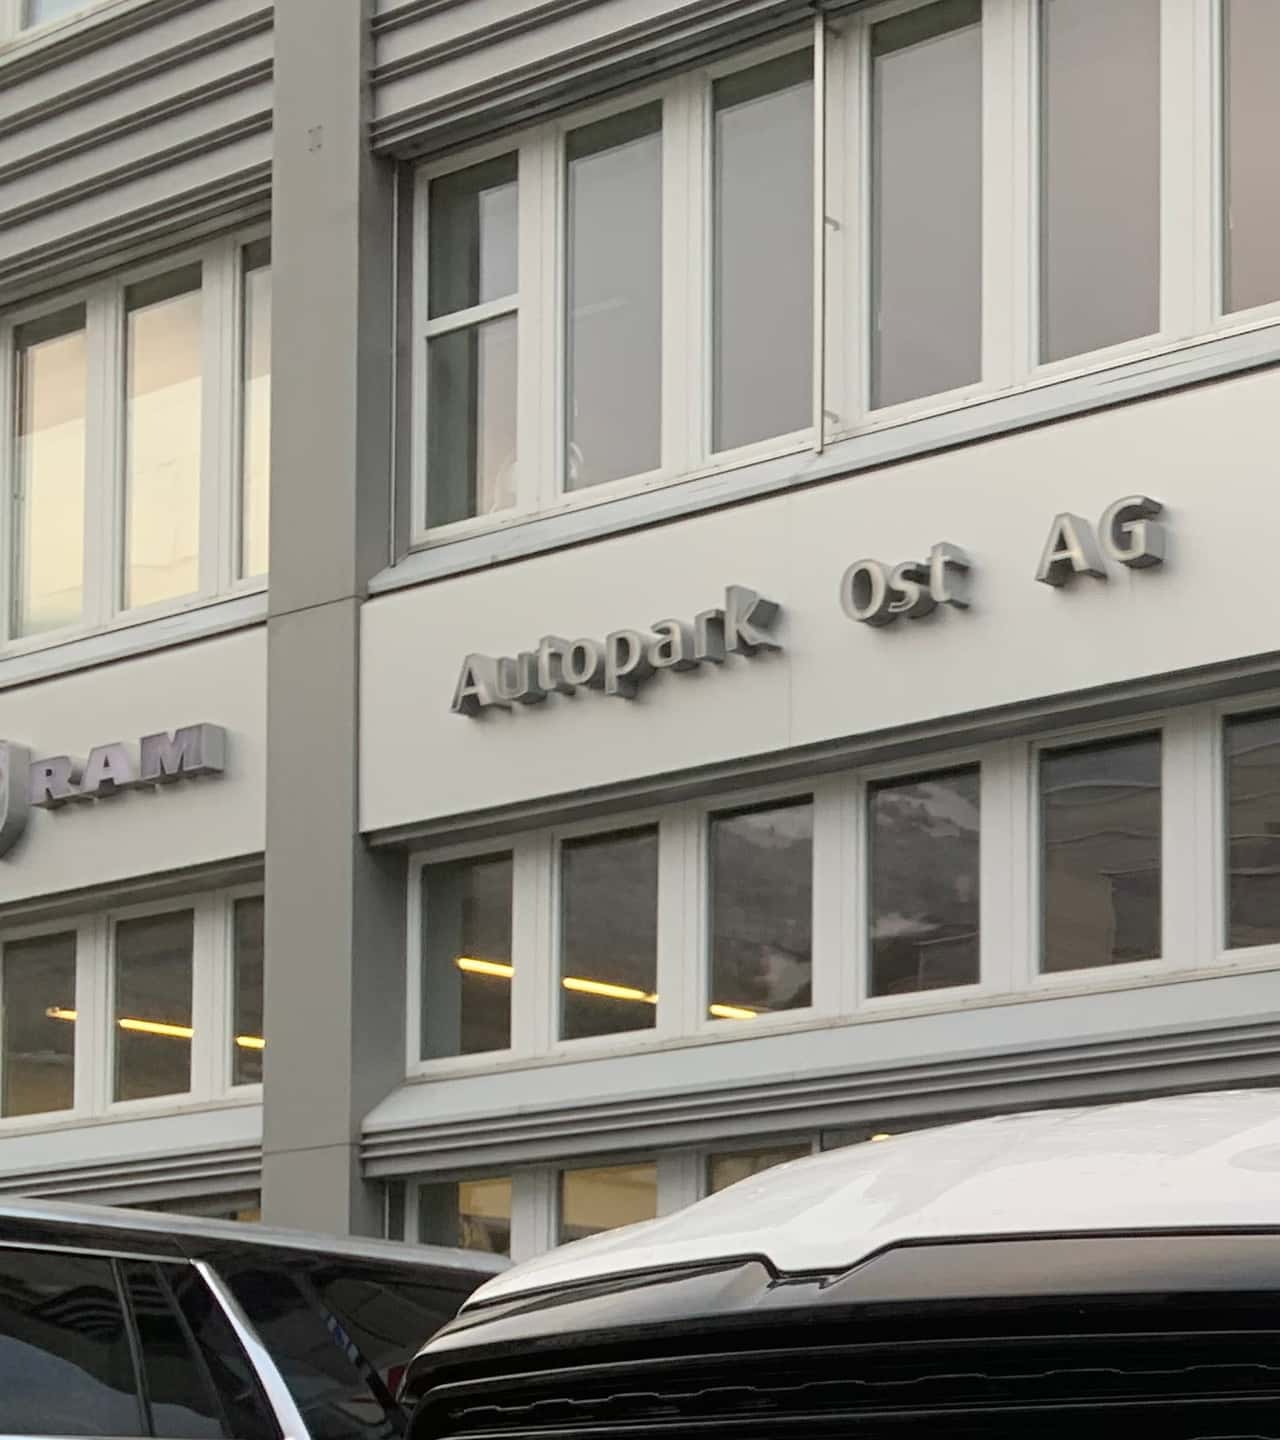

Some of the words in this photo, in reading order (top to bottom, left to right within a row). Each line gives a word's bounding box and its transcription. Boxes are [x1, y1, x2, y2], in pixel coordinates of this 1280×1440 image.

[451, 585, 782, 716] Autopark
[839, 541, 971, 627] Ost
[1035, 494, 1166, 587] AG
[30, 722, 226, 808] RAM
